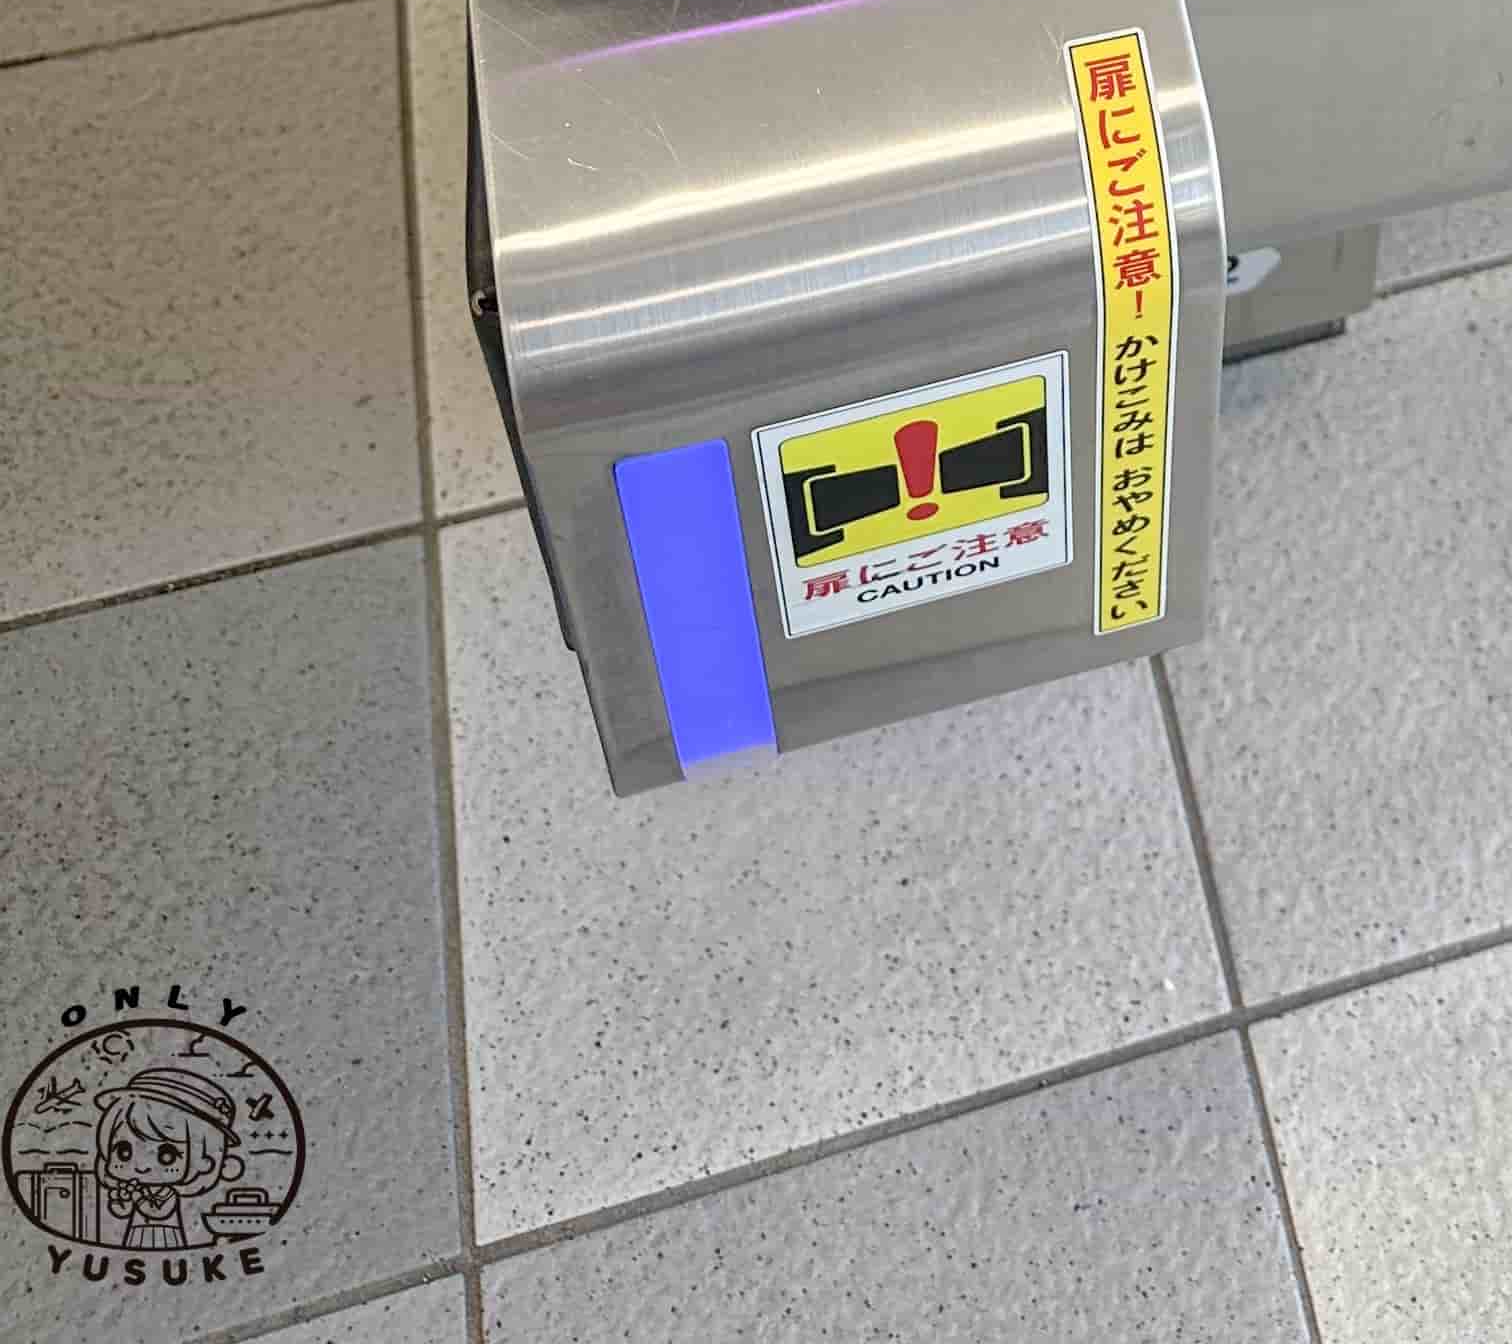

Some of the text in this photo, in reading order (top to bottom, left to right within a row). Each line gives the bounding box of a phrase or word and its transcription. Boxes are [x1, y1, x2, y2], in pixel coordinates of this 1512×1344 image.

[803, 518, 1050, 601] 扉にご注意
[856, 557, 1000, 604] CAUTION
